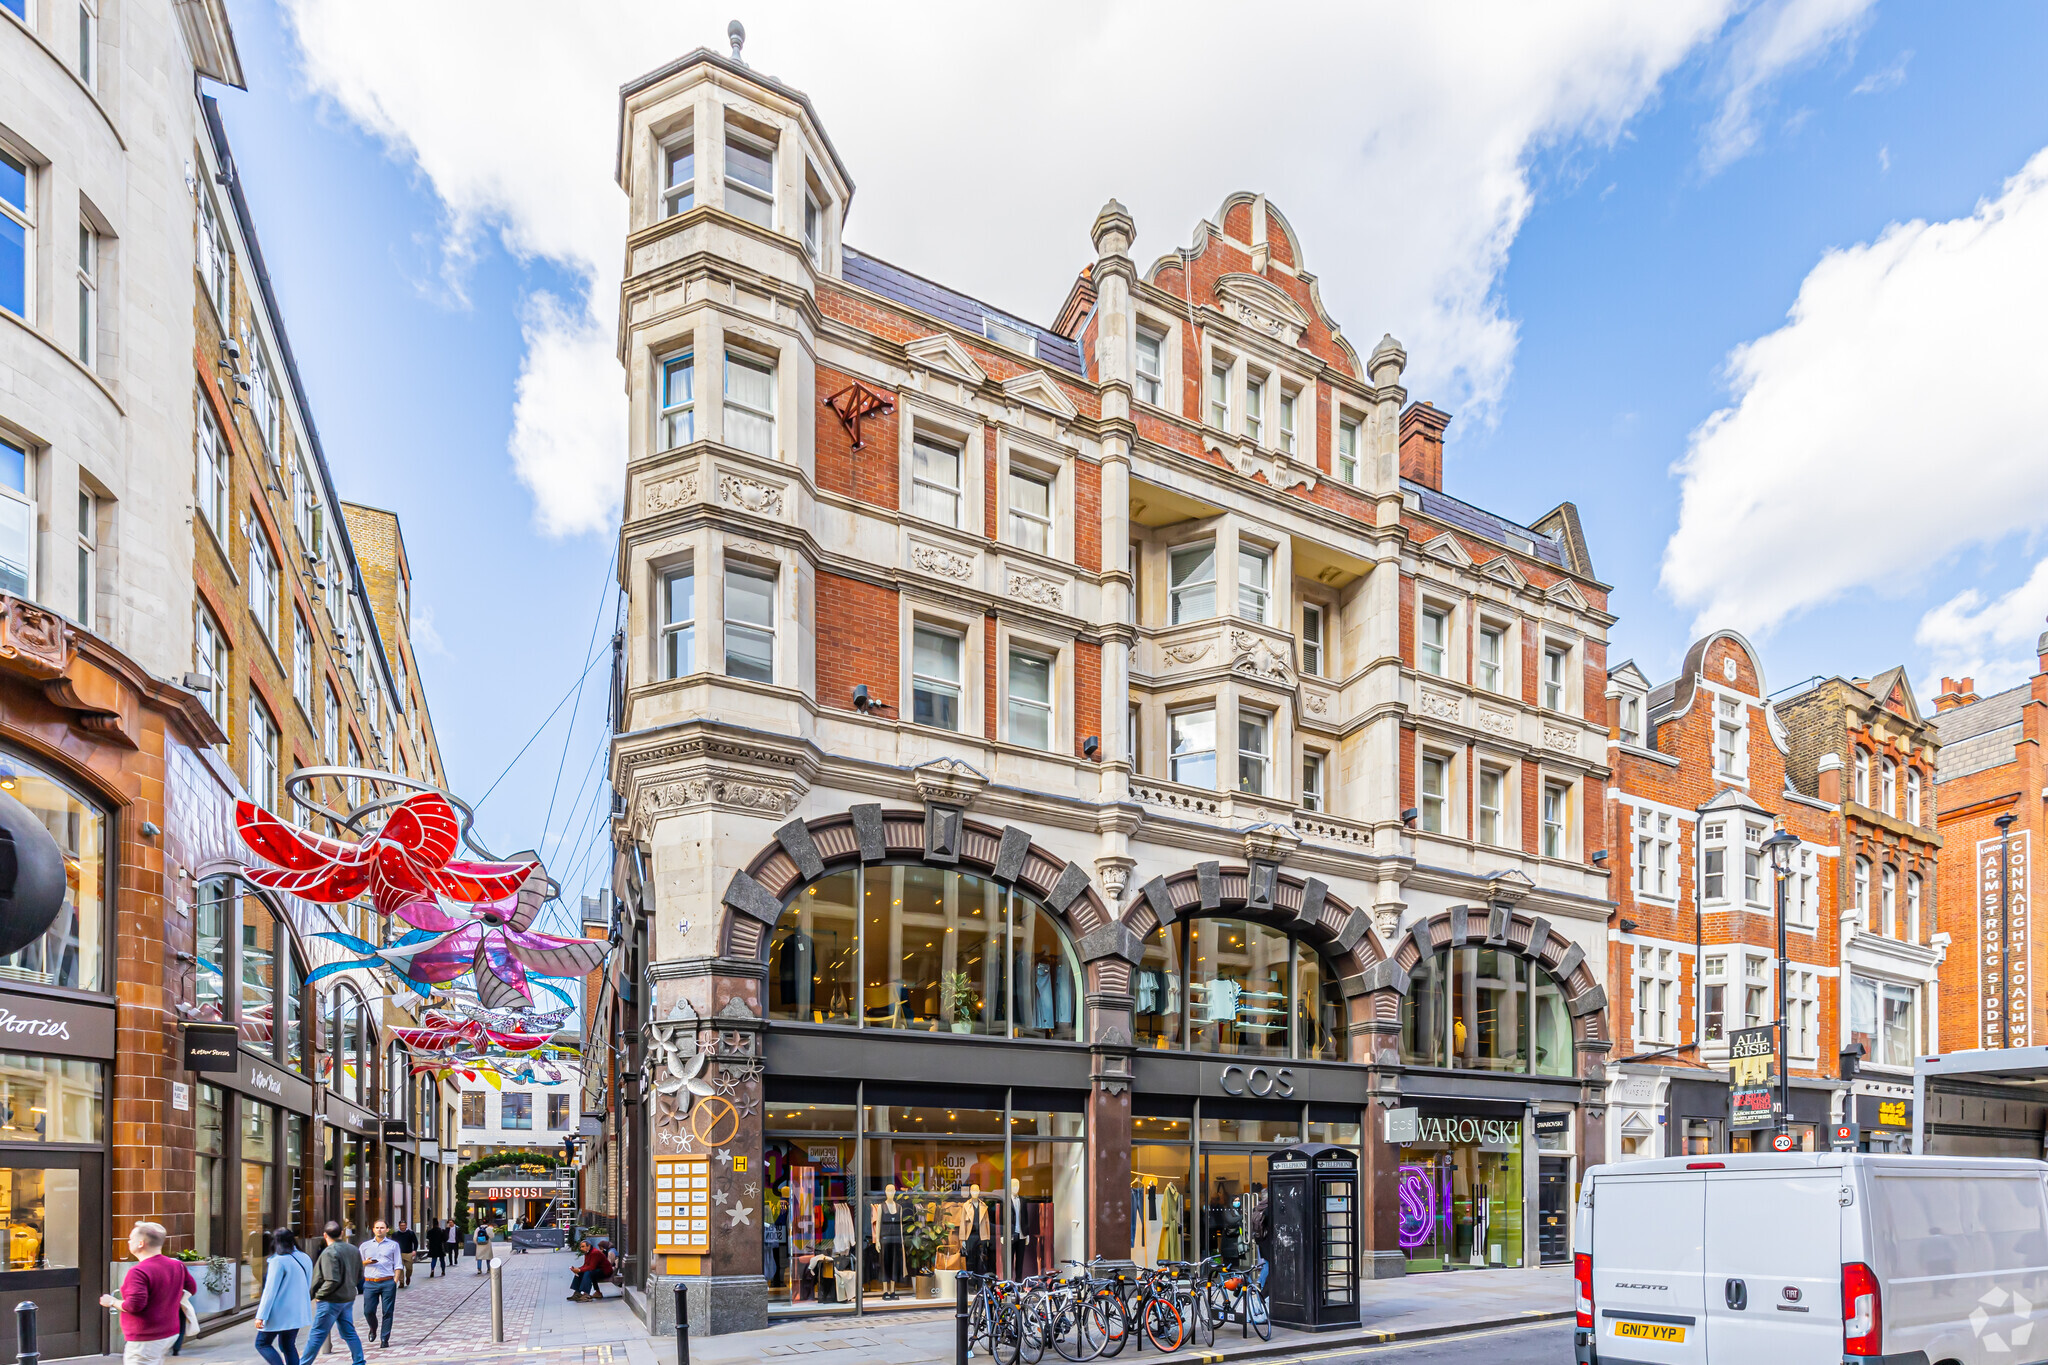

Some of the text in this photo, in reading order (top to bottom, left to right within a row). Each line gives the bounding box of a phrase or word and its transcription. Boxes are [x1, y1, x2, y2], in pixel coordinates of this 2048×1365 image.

[1981, 844, 2002, 854] LONDO
[2011, 841, 2026, 952] CONNAUGHT
[1984, 856, 1999, 1050] ARMSTRONG SIDDEL
[1735, 1032, 1767, 1047] ALL
[1733, 1042, 1770, 1058] RISE
[1220, 1064, 1294, 1098] COS
[1391, 1120, 1413, 1131] COS
[1417, 1117, 1519, 1145] WAROVSKI
[1537, 1121, 1563, 1129] SWAROVSKI
[1776, 1139, 1790, 1147] 20
[735, 1157, 746, 1170] H
[488, 1187, 542, 1198] MISCUSI
[1615, 1282, 1669, 1291] DUCATO
[1786, 1290, 1798, 1299] FIAT
[1622, 1323, 1677, 1339] GN17 VYP
